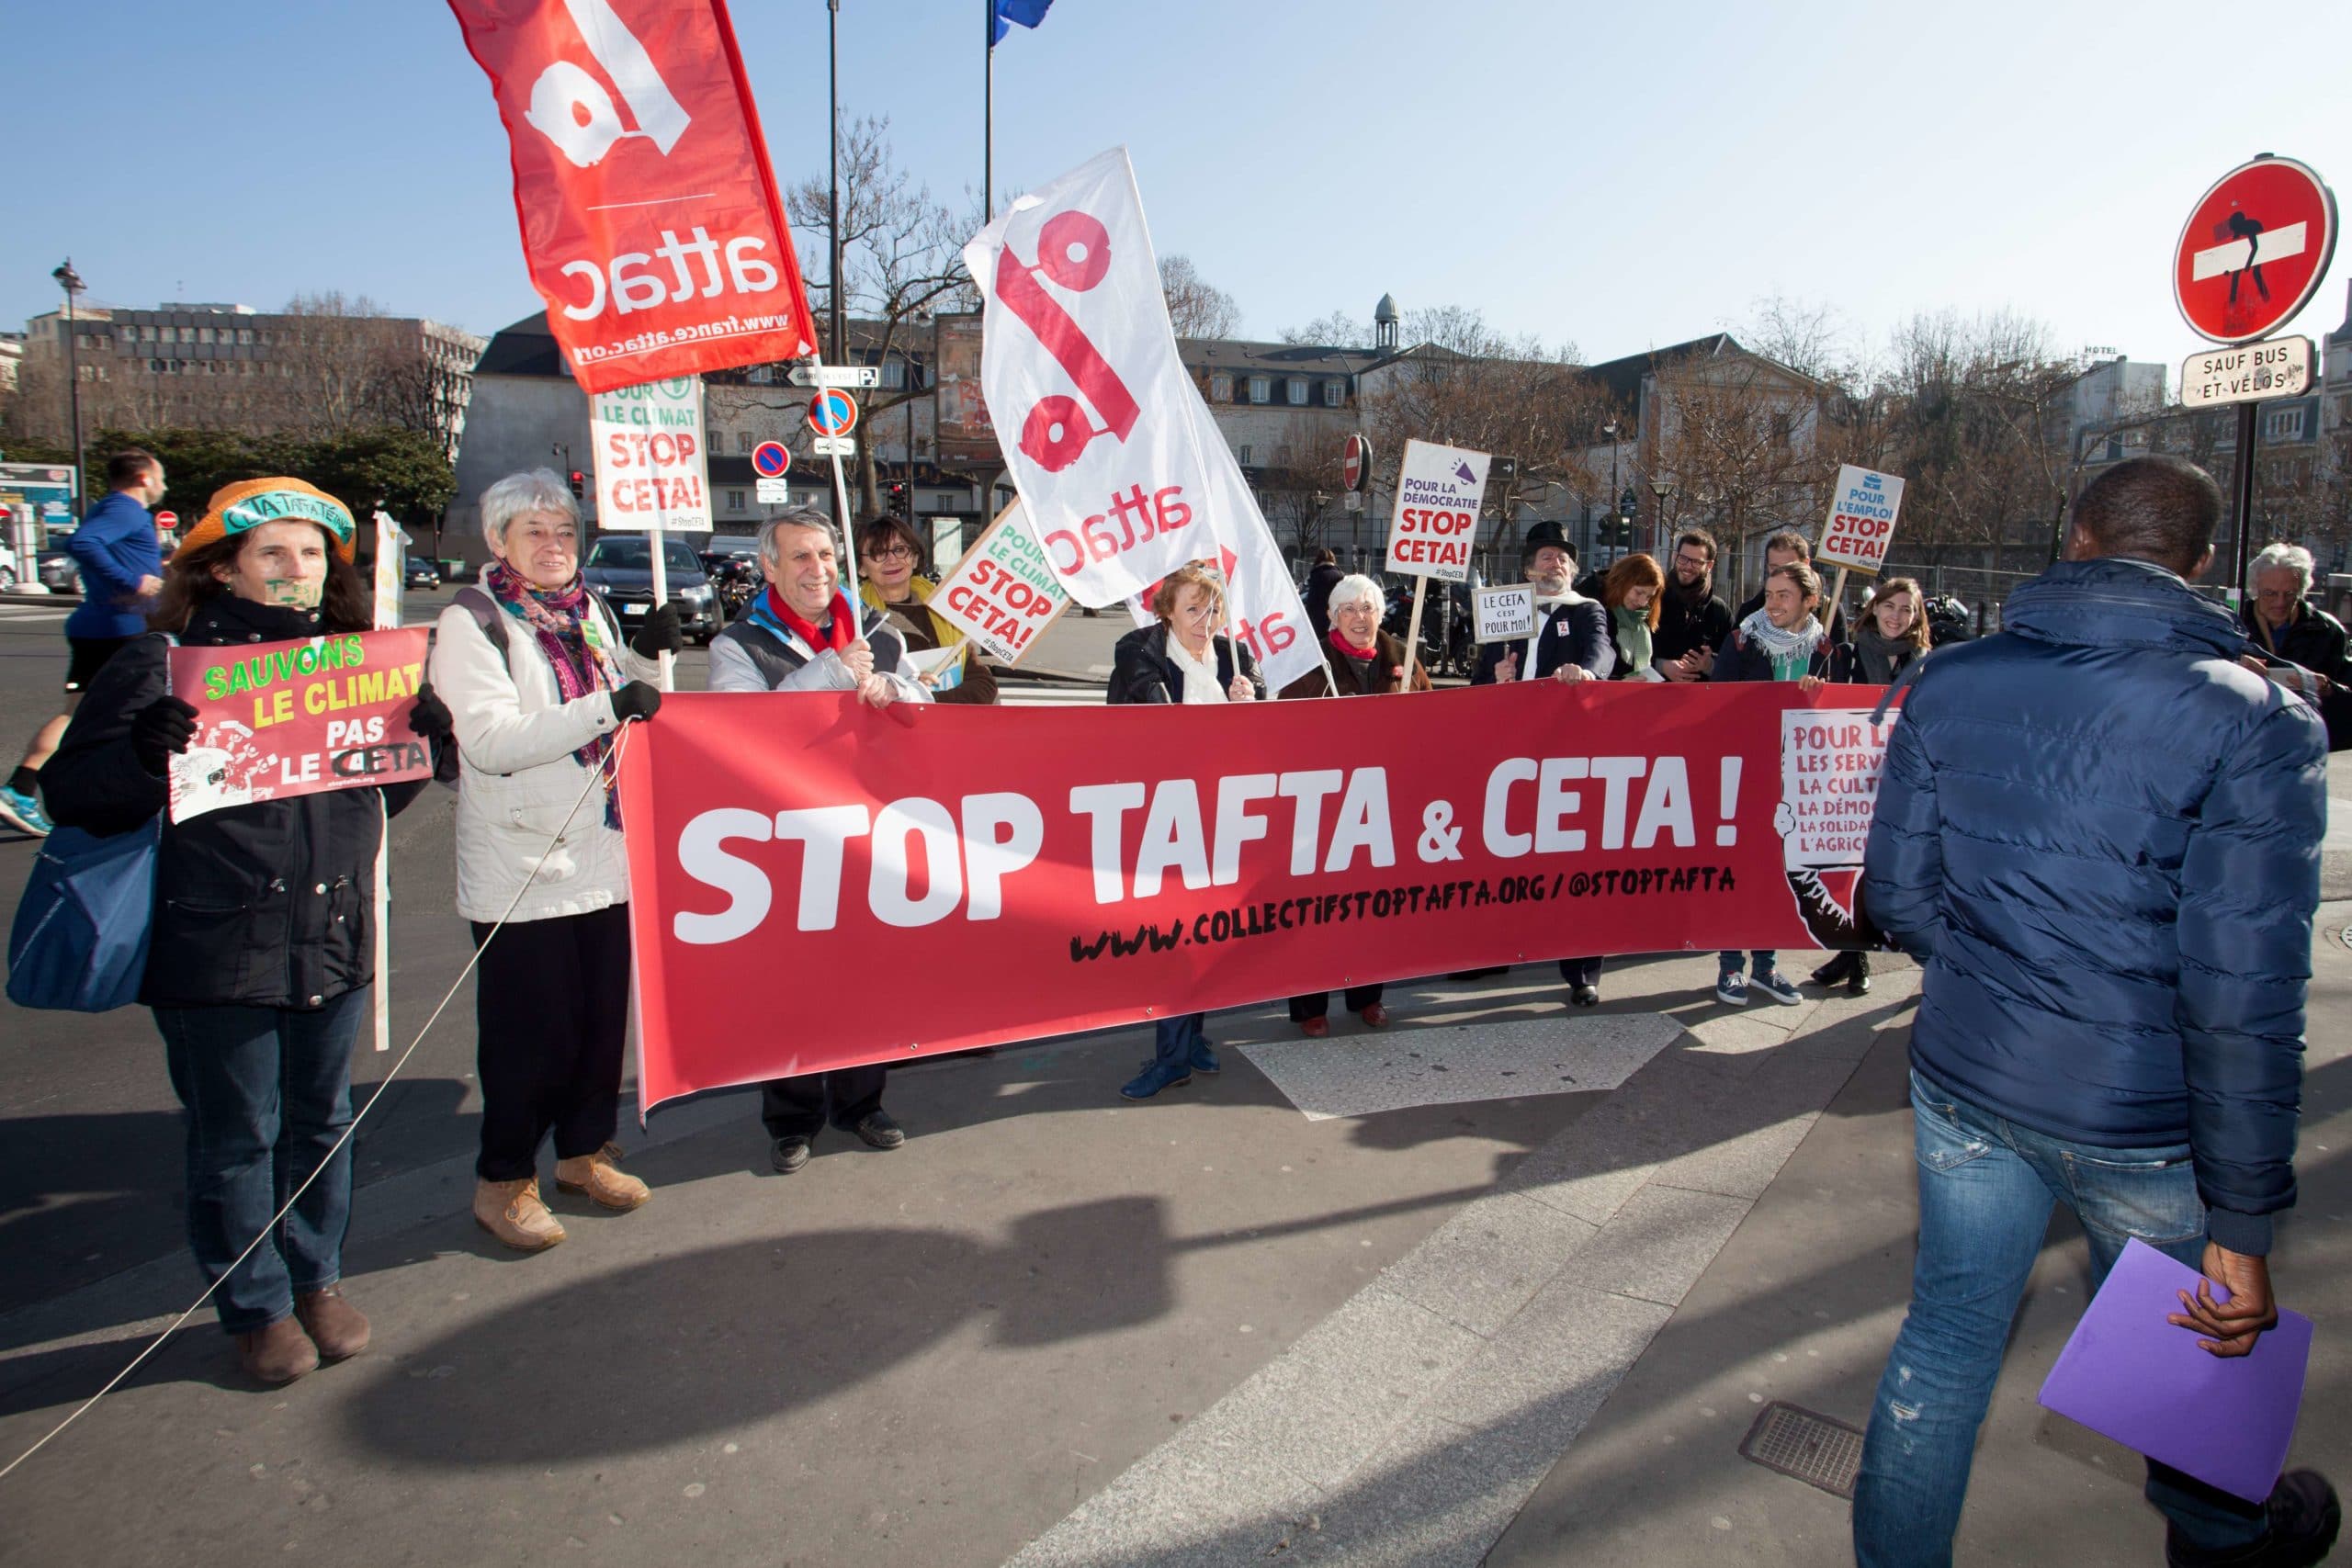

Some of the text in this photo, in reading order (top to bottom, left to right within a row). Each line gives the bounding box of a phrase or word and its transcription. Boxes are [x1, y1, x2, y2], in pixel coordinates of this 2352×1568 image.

[2085, 345, 2118, 355] HOTEL
[2203, 347, 2288, 375] SAUF BUS
[2203, 373, 2285, 399] ET VÉLOS
[604, 405, 695, 426] LE CLIMAT
[610, 433, 695, 468] STOP
[613, 476, 702, 513] CETA!
[1405, 478, 1457, 494] POUR LA
[1849, 488, 1885, 505] POUR
[1403, 490, 1478, 510] DÉMOCRATIE
[1837, 501, 1894, 520] L'EMPLOI
[1400, 508, 1472, 536] STOP
[1832, 513, 1890, 538] STOP
[1000, 525, 1046, 565] POUR
[1394, 538, 1467, 566] CETA!
[1826, 535, 1885, 559] CETA!
[988, 541, 1068, 601] LE CLIMAT
[969, 559, 1053, 618] STOP
[1484, 593, 1525, 609] LE CETA
[948, 586, 1034, 650] CETA!
[1485, 621, 1509, 634] POUR
[204, 634, 365, 701] SAUVONS
[254, 662, 422, 729] LE CLIMAT
[326, 716, 385, 749] PAS
[1793, 725, 1862, 750] POUR
[281, 753, 321, 785] LE
[1797, 753, 1888, 773] LES SERV
[1799, 778, 1822, 795] LA
[1798, 801, 1819, 816] LA
[1800, 820, 1816, 832] LA
[673, 791, 1045, 946] STOP
[1069, 765, 1396, 905] TAFTA
[1418, 799, 1464, 863] &
[1482, 754, 1698, 859] CETA
[1567, 867, 1736, 899] @STOPTAFTA
